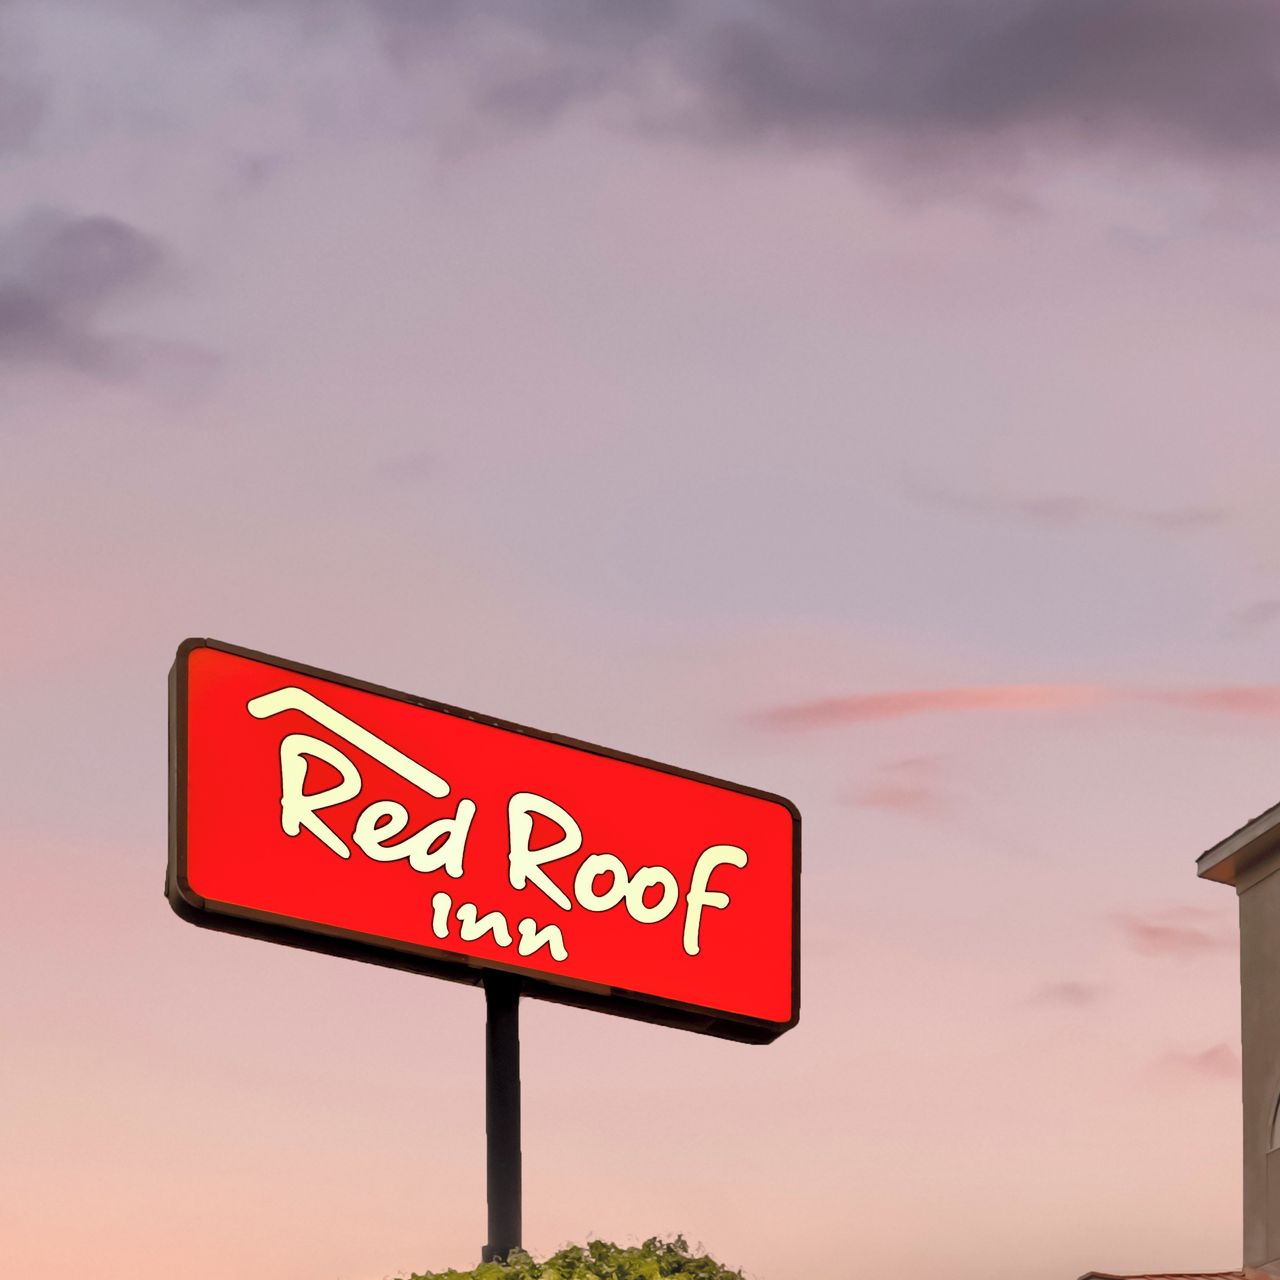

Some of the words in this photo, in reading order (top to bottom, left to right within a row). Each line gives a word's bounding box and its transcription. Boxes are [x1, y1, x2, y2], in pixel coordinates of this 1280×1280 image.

[279, 732, 477, 879] Red
[506, 791, 749, 957] Roof
[430, 891, 570, 962] Inn
